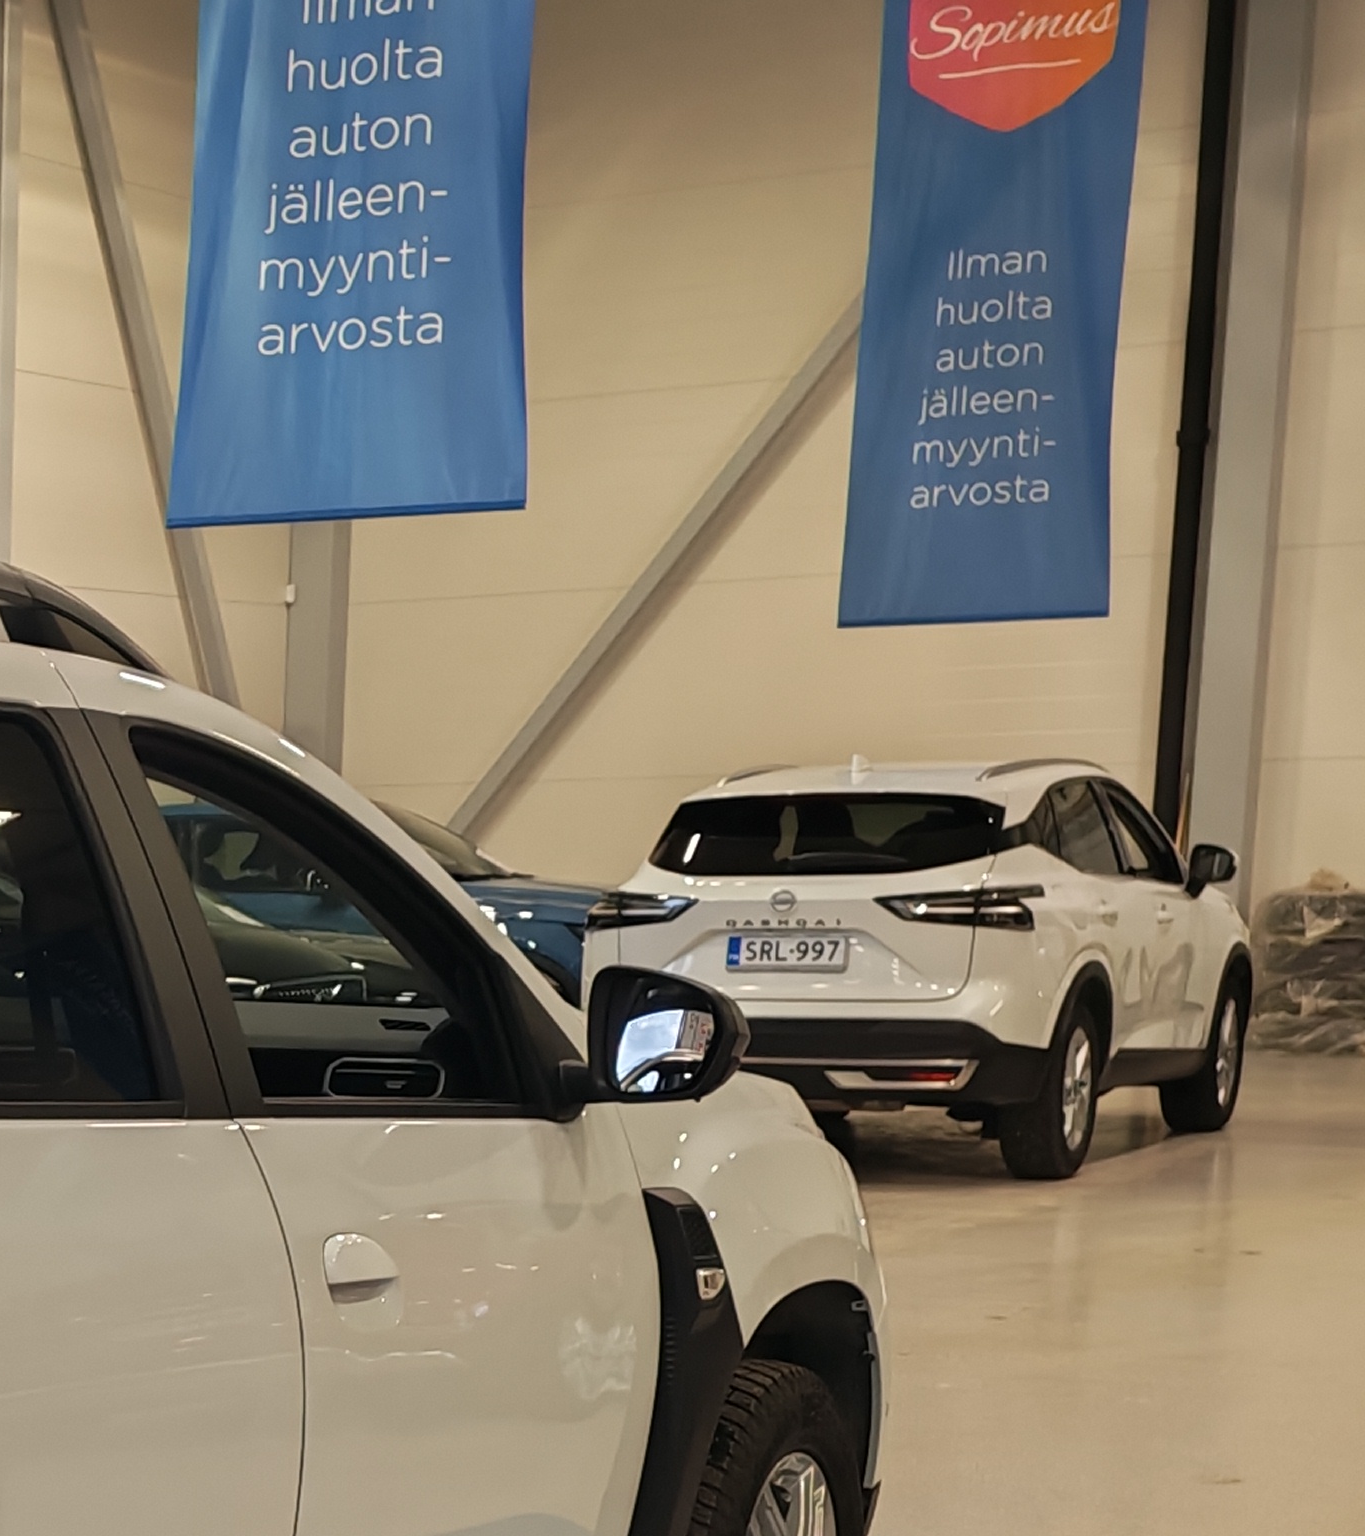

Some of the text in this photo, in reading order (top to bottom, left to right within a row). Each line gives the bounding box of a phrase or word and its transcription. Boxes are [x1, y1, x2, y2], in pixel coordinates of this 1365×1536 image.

[910, 2, 1116, 61] Sopimus
[287, 38, 443, 92] huolta
[289, 112, 433, 158] auton
[264, 178, 449, 235] jälleen-
[259, 235, 452, 297] myynti-
[947, 248, 1048, 281] Ilman
[257, 305, 443, 355] arvosta
[936, 290, 1052, 327] huolta
[936, 340, 1045, 372] auton
[917, 385, 1055, 426] jälleen-
[912, 427, 1057, 467] myynti-
[909, 475, 1050, 509] arvosta
